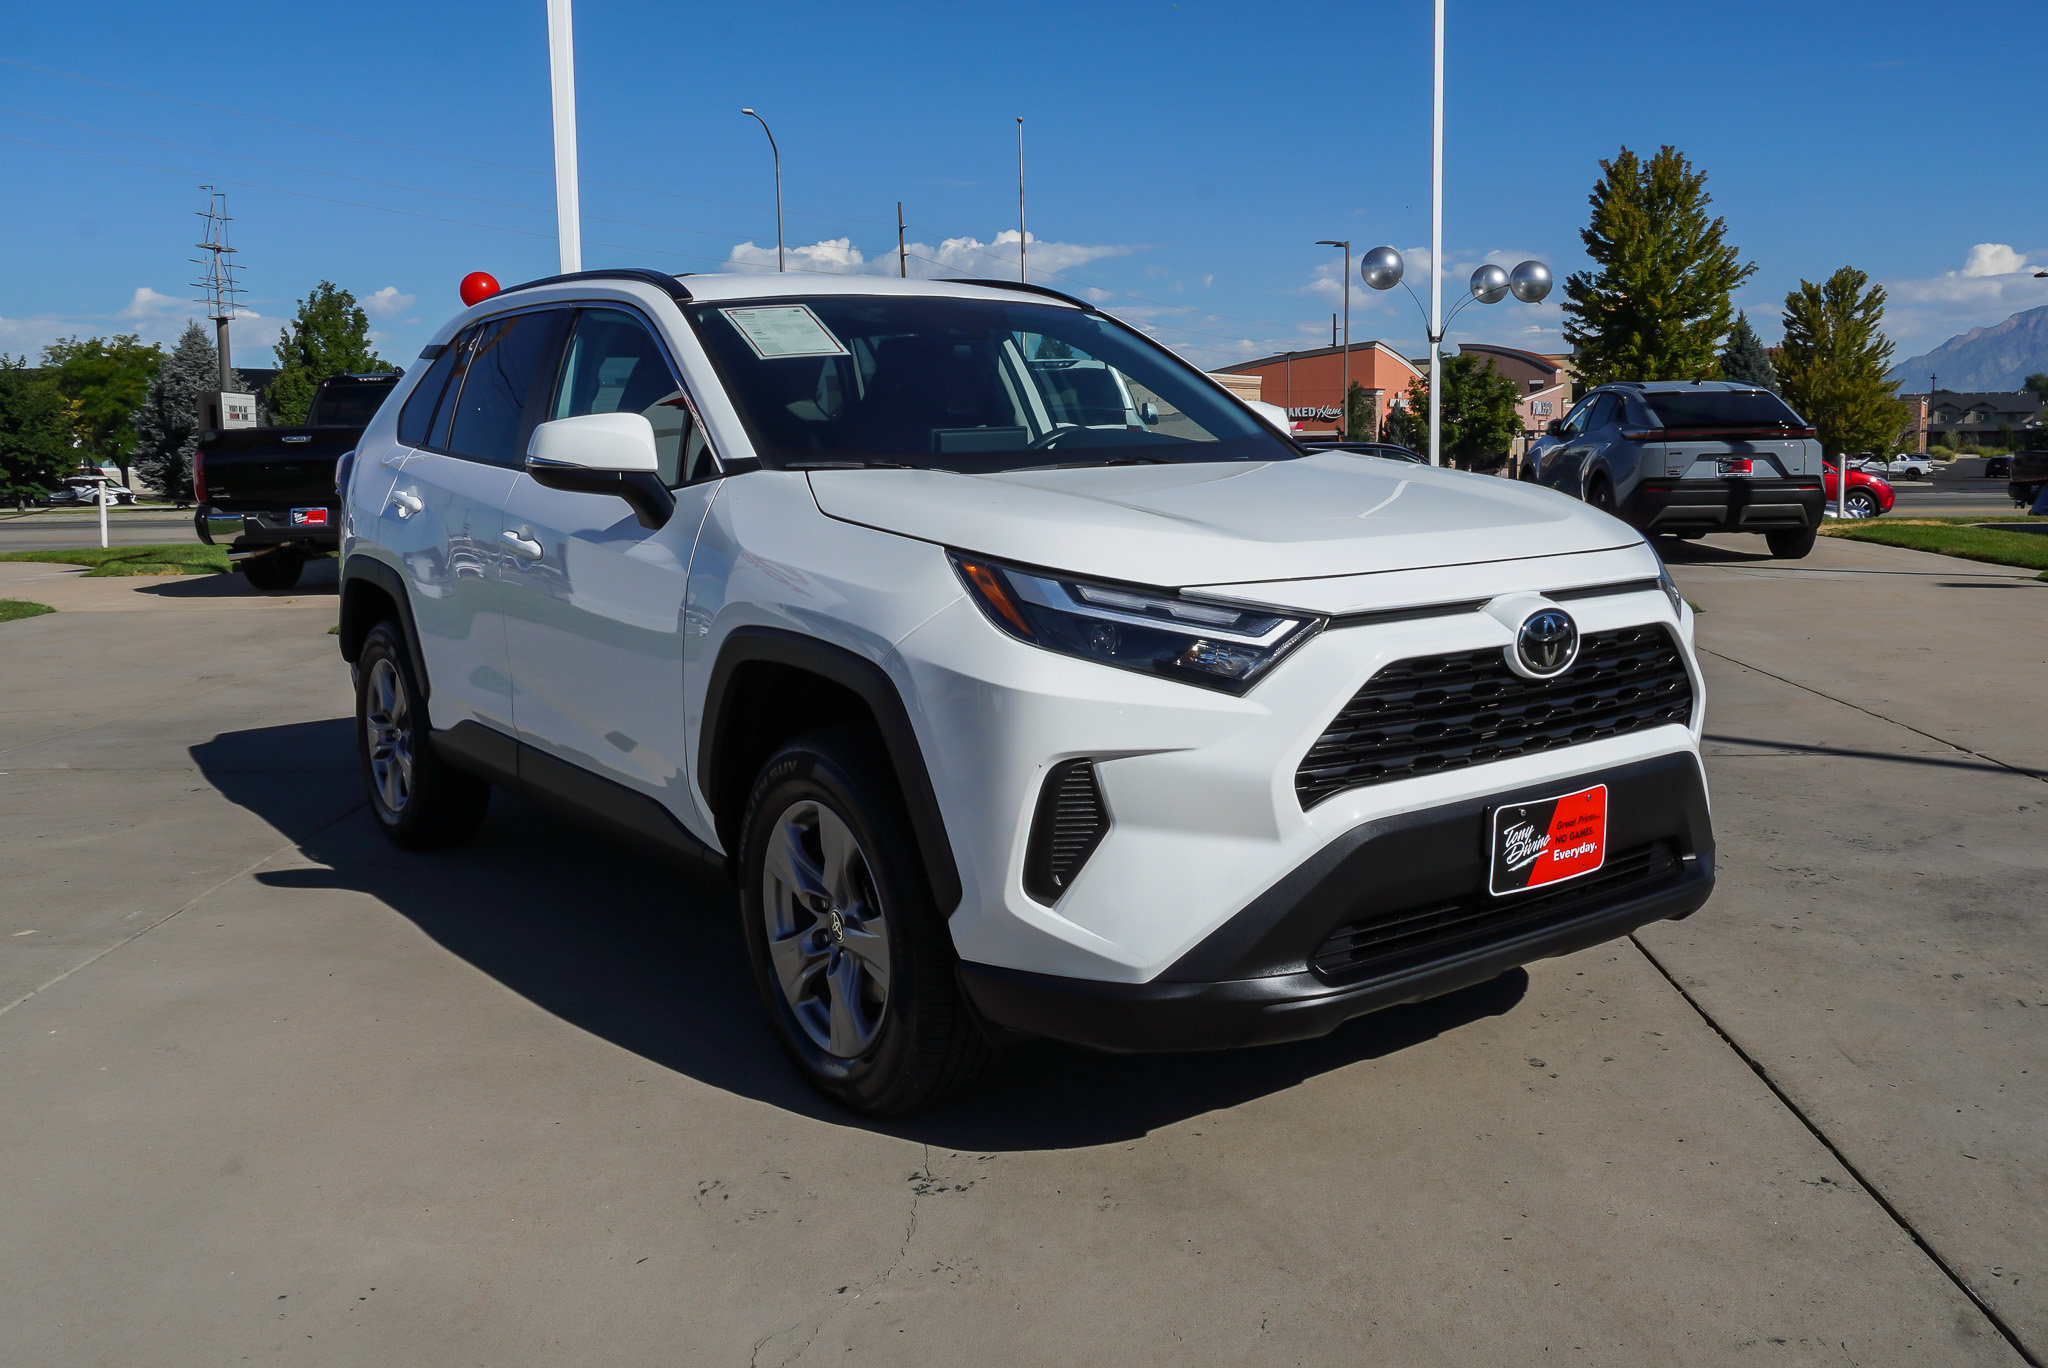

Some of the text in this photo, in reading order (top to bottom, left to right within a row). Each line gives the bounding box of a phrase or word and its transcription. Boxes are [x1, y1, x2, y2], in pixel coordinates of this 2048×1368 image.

[1284, 404, 1343, 419] AKED Ham
[1503, 820, 1535, 848] Tony
[1555, 834, 1568, 845] NO
[1553, 841, 1598, 861] Everyday.
